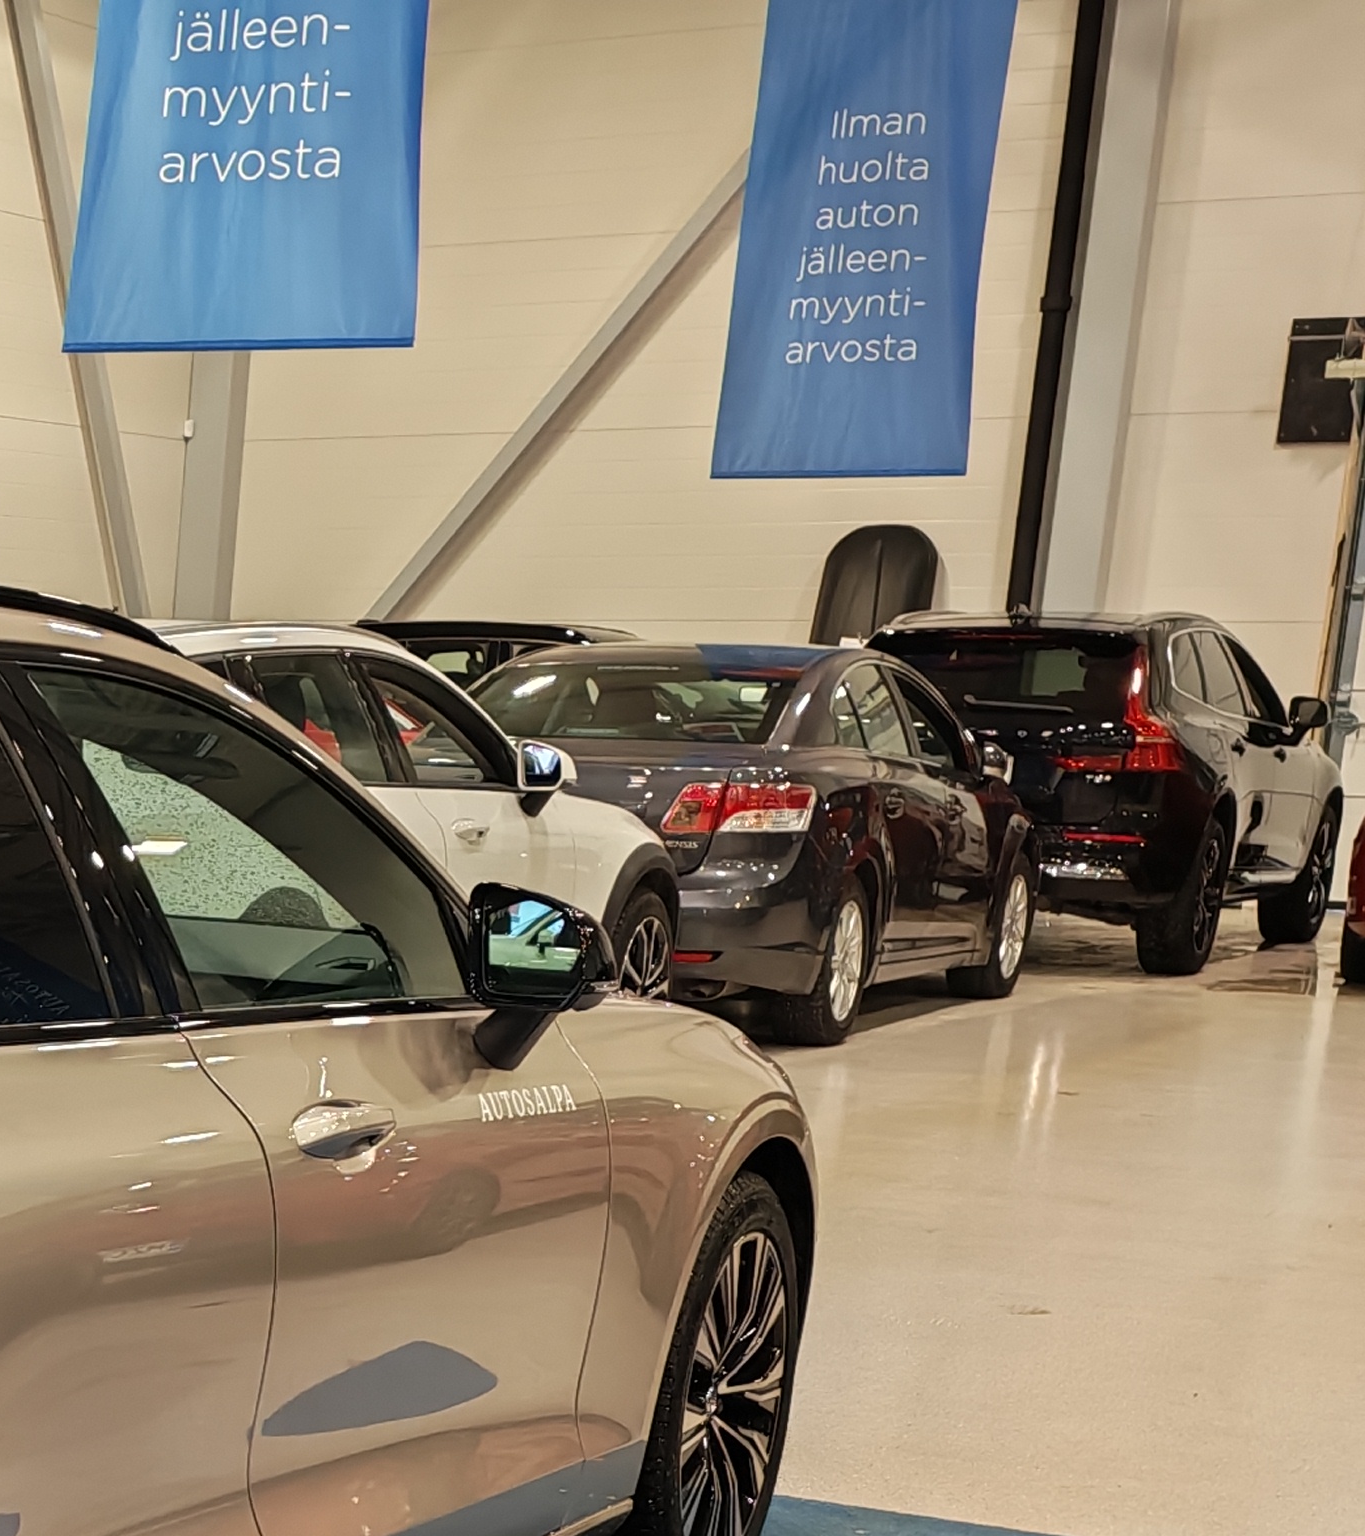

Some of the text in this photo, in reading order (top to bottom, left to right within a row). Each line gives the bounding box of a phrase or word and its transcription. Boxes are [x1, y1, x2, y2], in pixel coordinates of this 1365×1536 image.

[169, 7, 352, 62] jälleen-
[161, 68, 352, 127] myynti-
[831, 107, 928, 140] Ilman
[158, 138, 342, 184] arvosta
[817, 150, 930, 186] huolta
[815, 199, 920, 231] auton
[795, 242, 929, 283] jälleen-
[788, 286, 928, 325] myynti-
[784, 333, 919, 365] arvosta
[477, 1083, 578, 1123] AUTOSALPA
